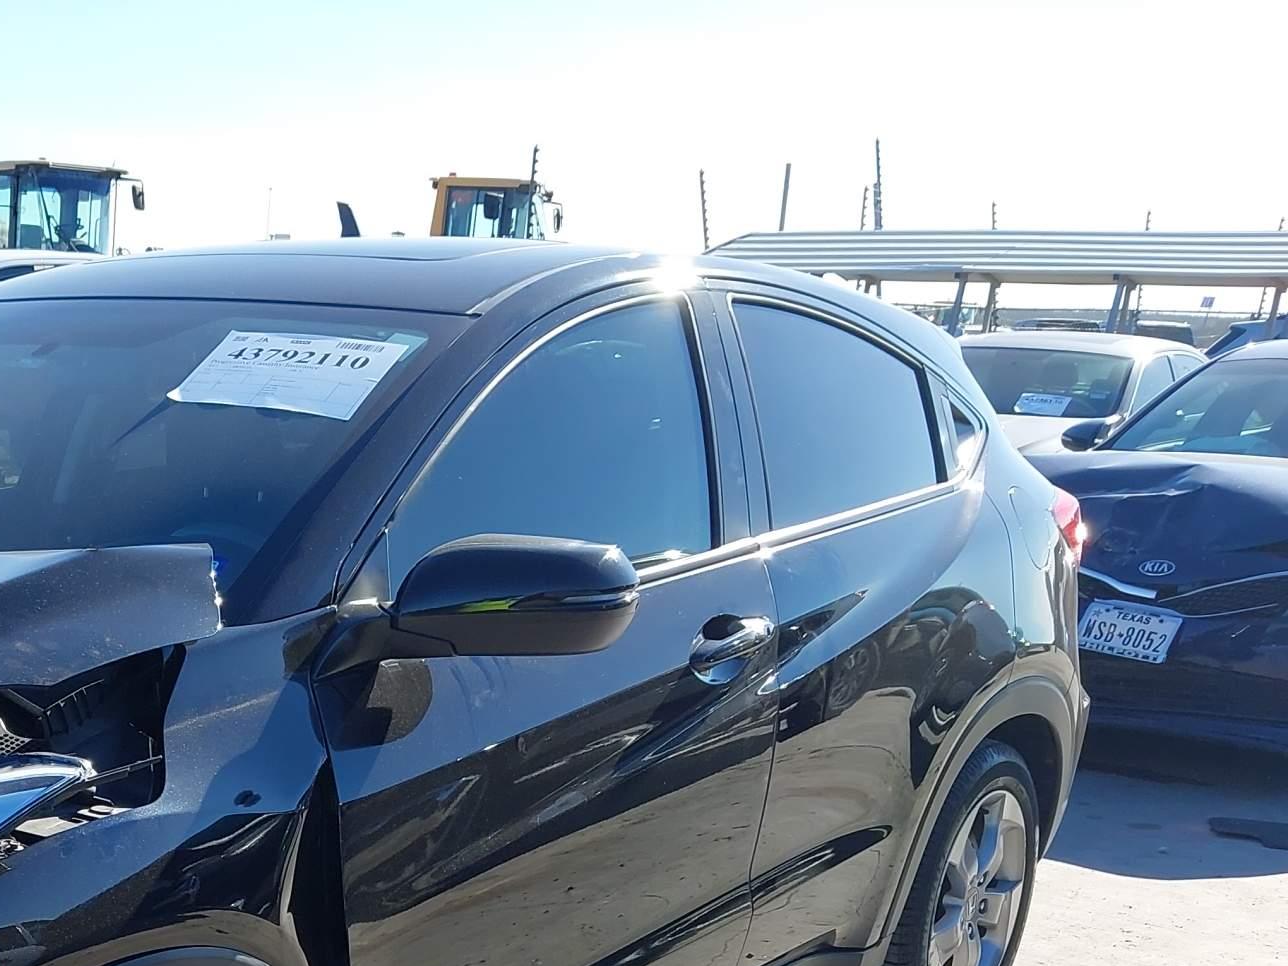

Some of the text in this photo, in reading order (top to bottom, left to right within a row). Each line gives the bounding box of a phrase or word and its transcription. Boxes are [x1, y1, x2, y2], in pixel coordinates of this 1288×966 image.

[227, 346, 370, 370] 43792110
[1144, 561, 1168, 573] KIA
[1116, 611, 1152, 625] TEXAS
